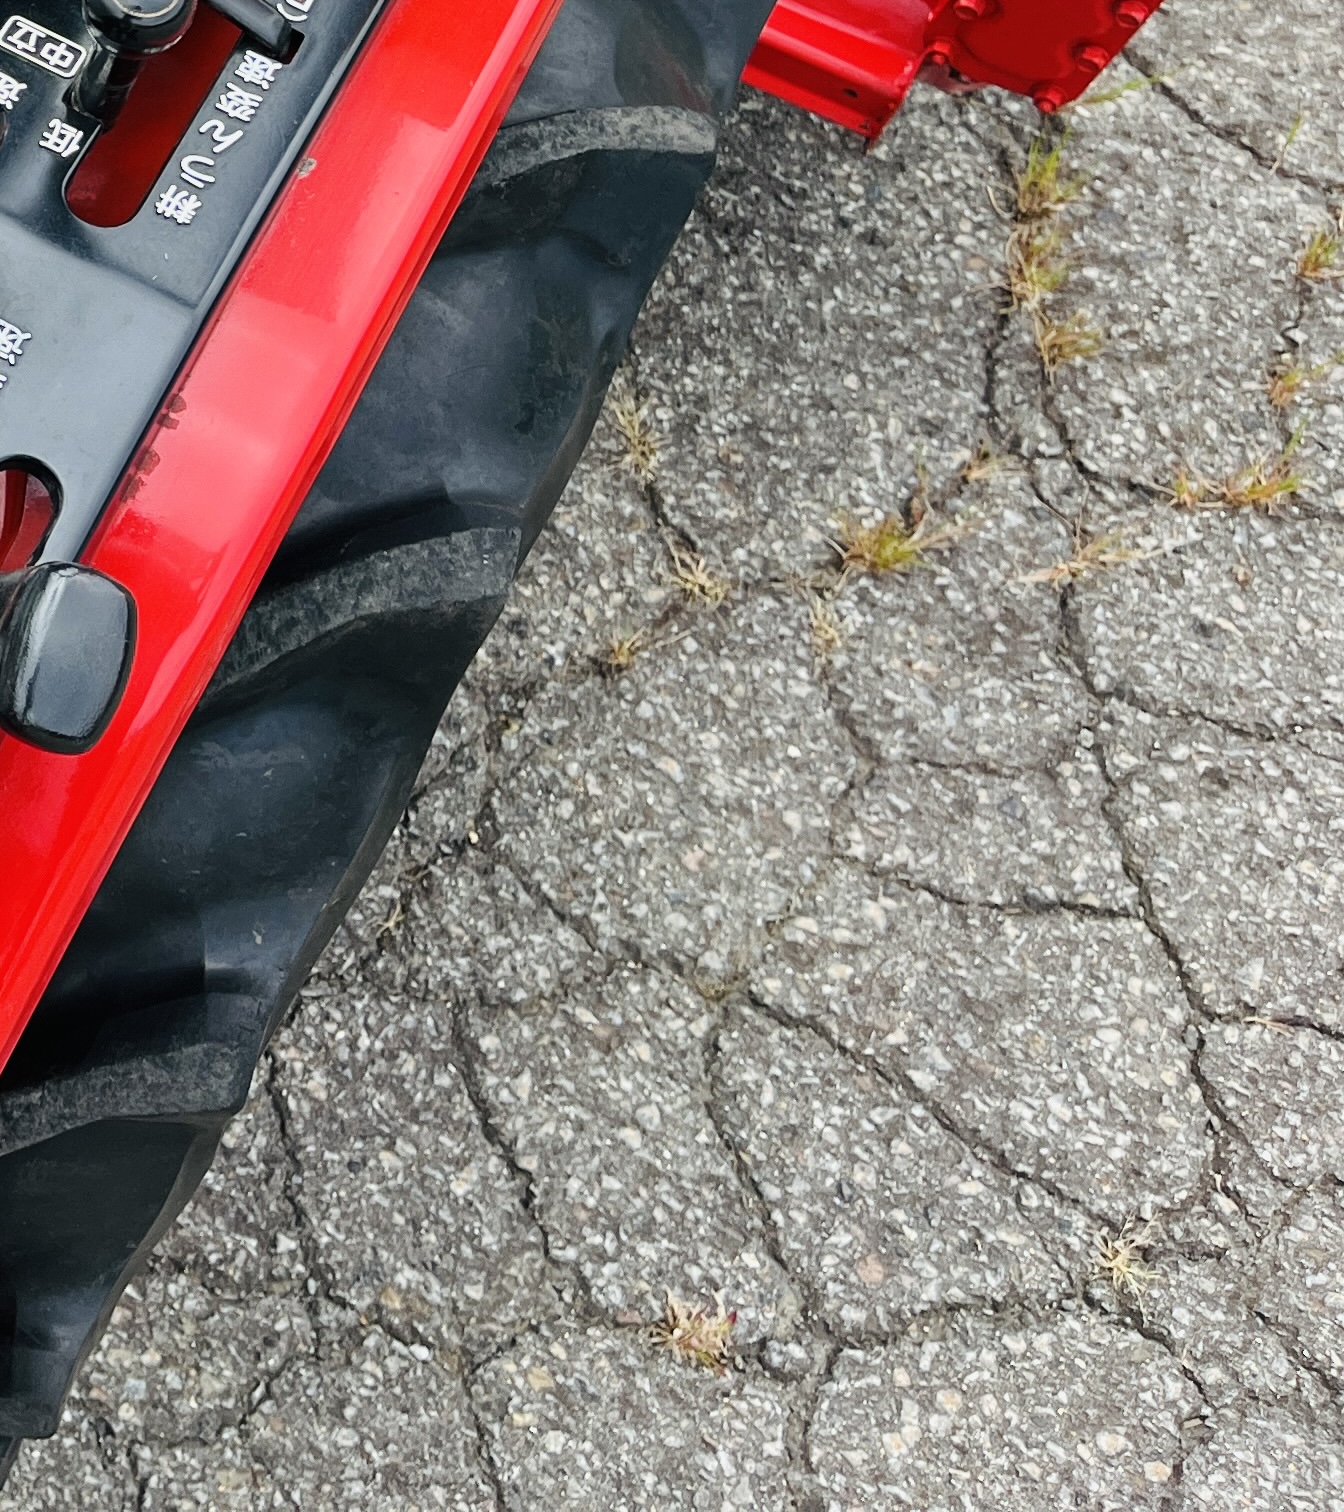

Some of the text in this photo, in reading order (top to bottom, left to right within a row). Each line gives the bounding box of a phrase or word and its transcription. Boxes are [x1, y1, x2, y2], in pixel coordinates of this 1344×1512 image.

[8, 20, 76, 69] 中立
[154, 49, 283, 225] 耕うん変速
